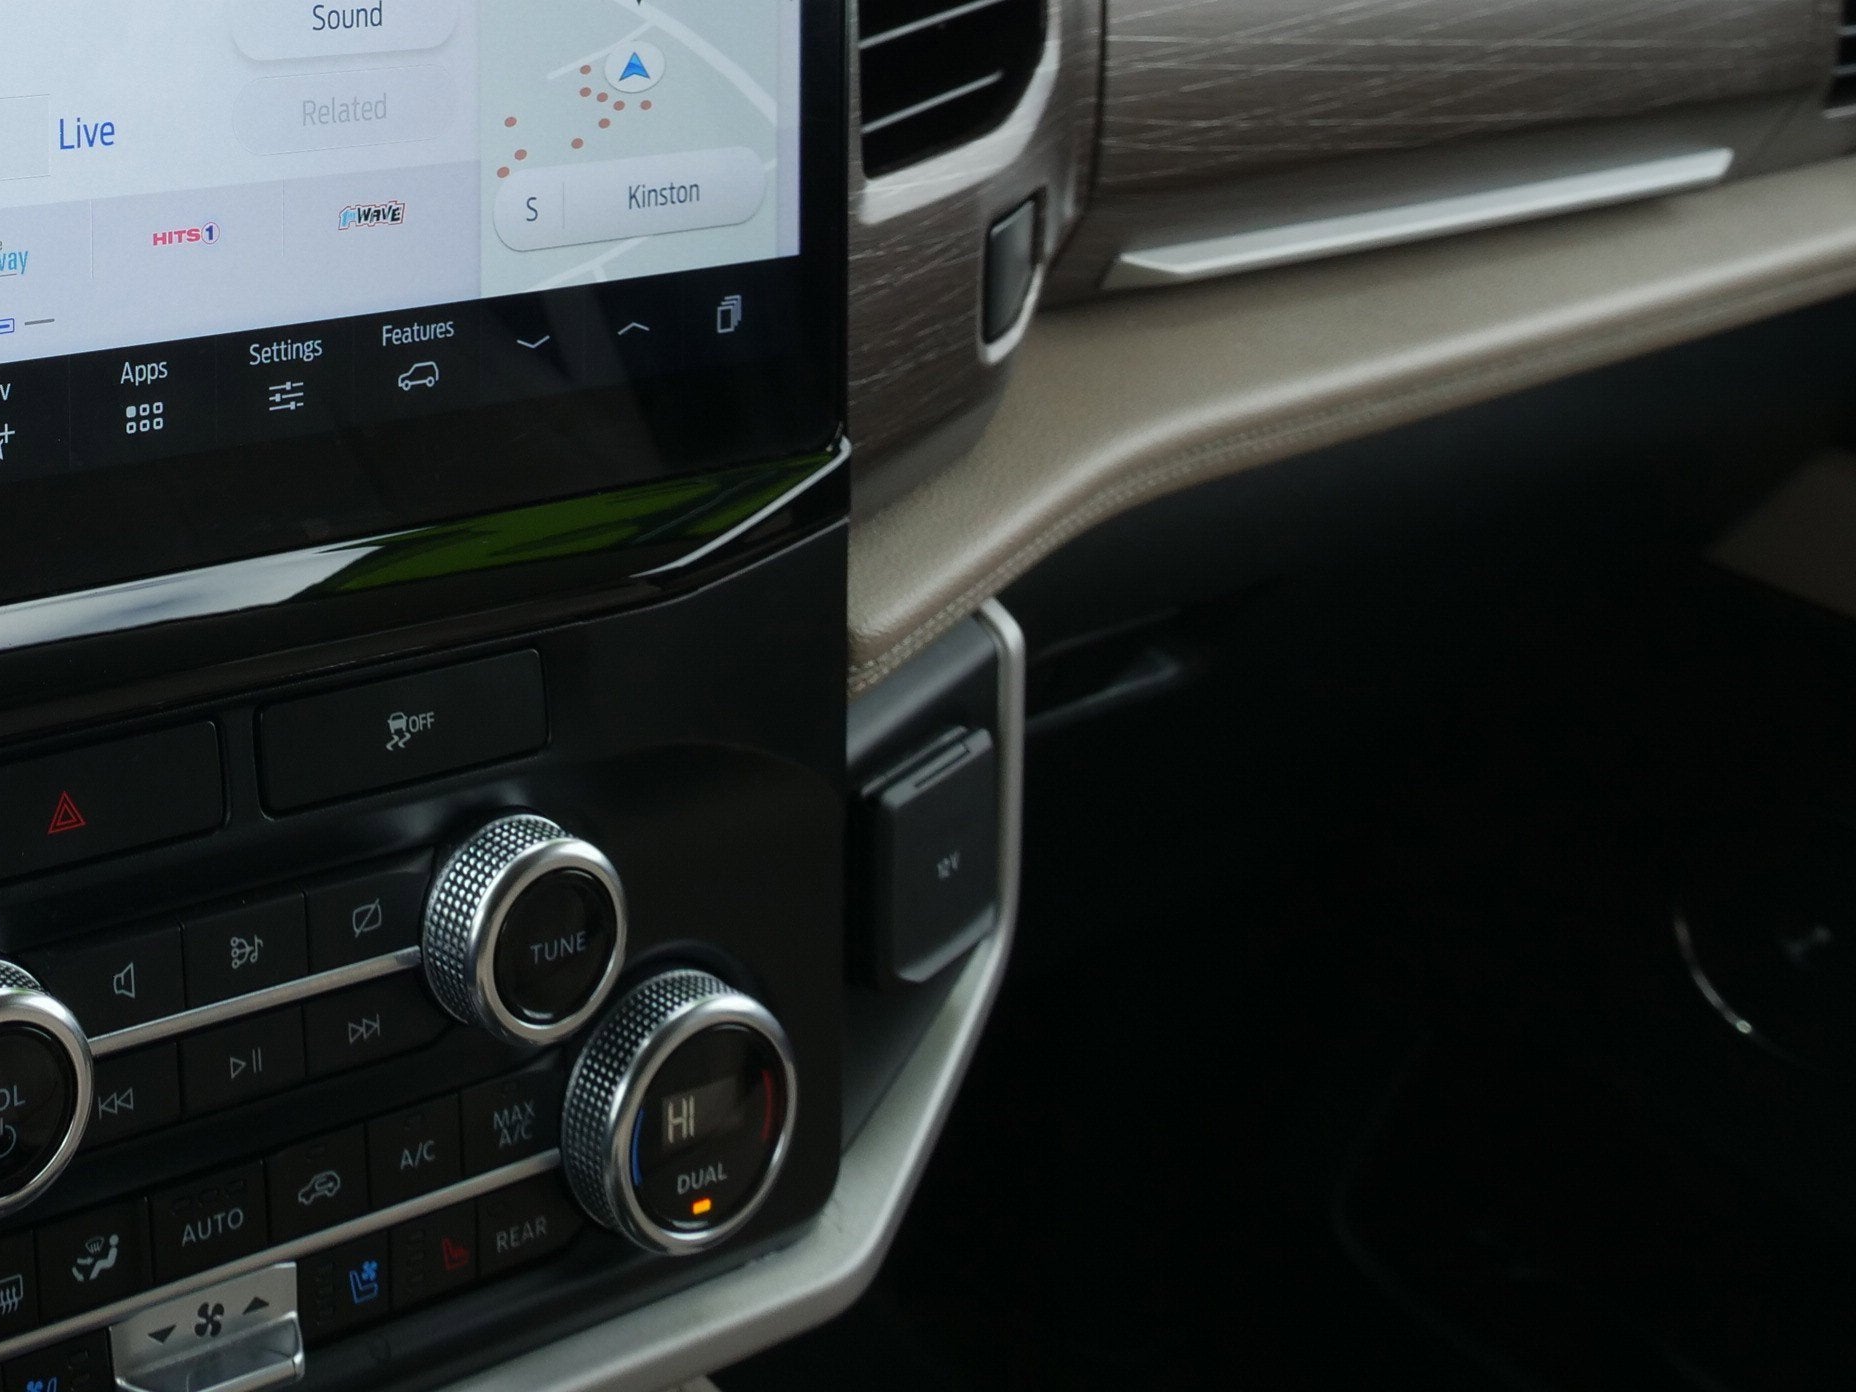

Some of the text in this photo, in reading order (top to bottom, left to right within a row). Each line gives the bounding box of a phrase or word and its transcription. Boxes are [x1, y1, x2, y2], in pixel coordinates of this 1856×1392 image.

[311, 0, 384, 32] Sound
[301, 93, 388, 127] Related
[59, 118, 116, 150] Live
[525, 196, 539, 222] S
[628, 180, 701, 209] Kinston
[381, 319, 455, 347] Features
[249, 336, 323, 365] Settings
[120, 359, 168, 384] Apps
[409, 711, 436, 733] OFF
[531, 930, 588, 964] TUNE
[493, 1100, 537, 1127] MAX
[667, 1096, 697, 1142] HI
[499, 1122, 534, 1146] A/C
[399, 1140, 437, 1169] A/C
[676, 1163, 728, 1194] DUAL
[181, 1207, 244, 1245] AUTO
[495, 1214, 548, 1253] REAR
